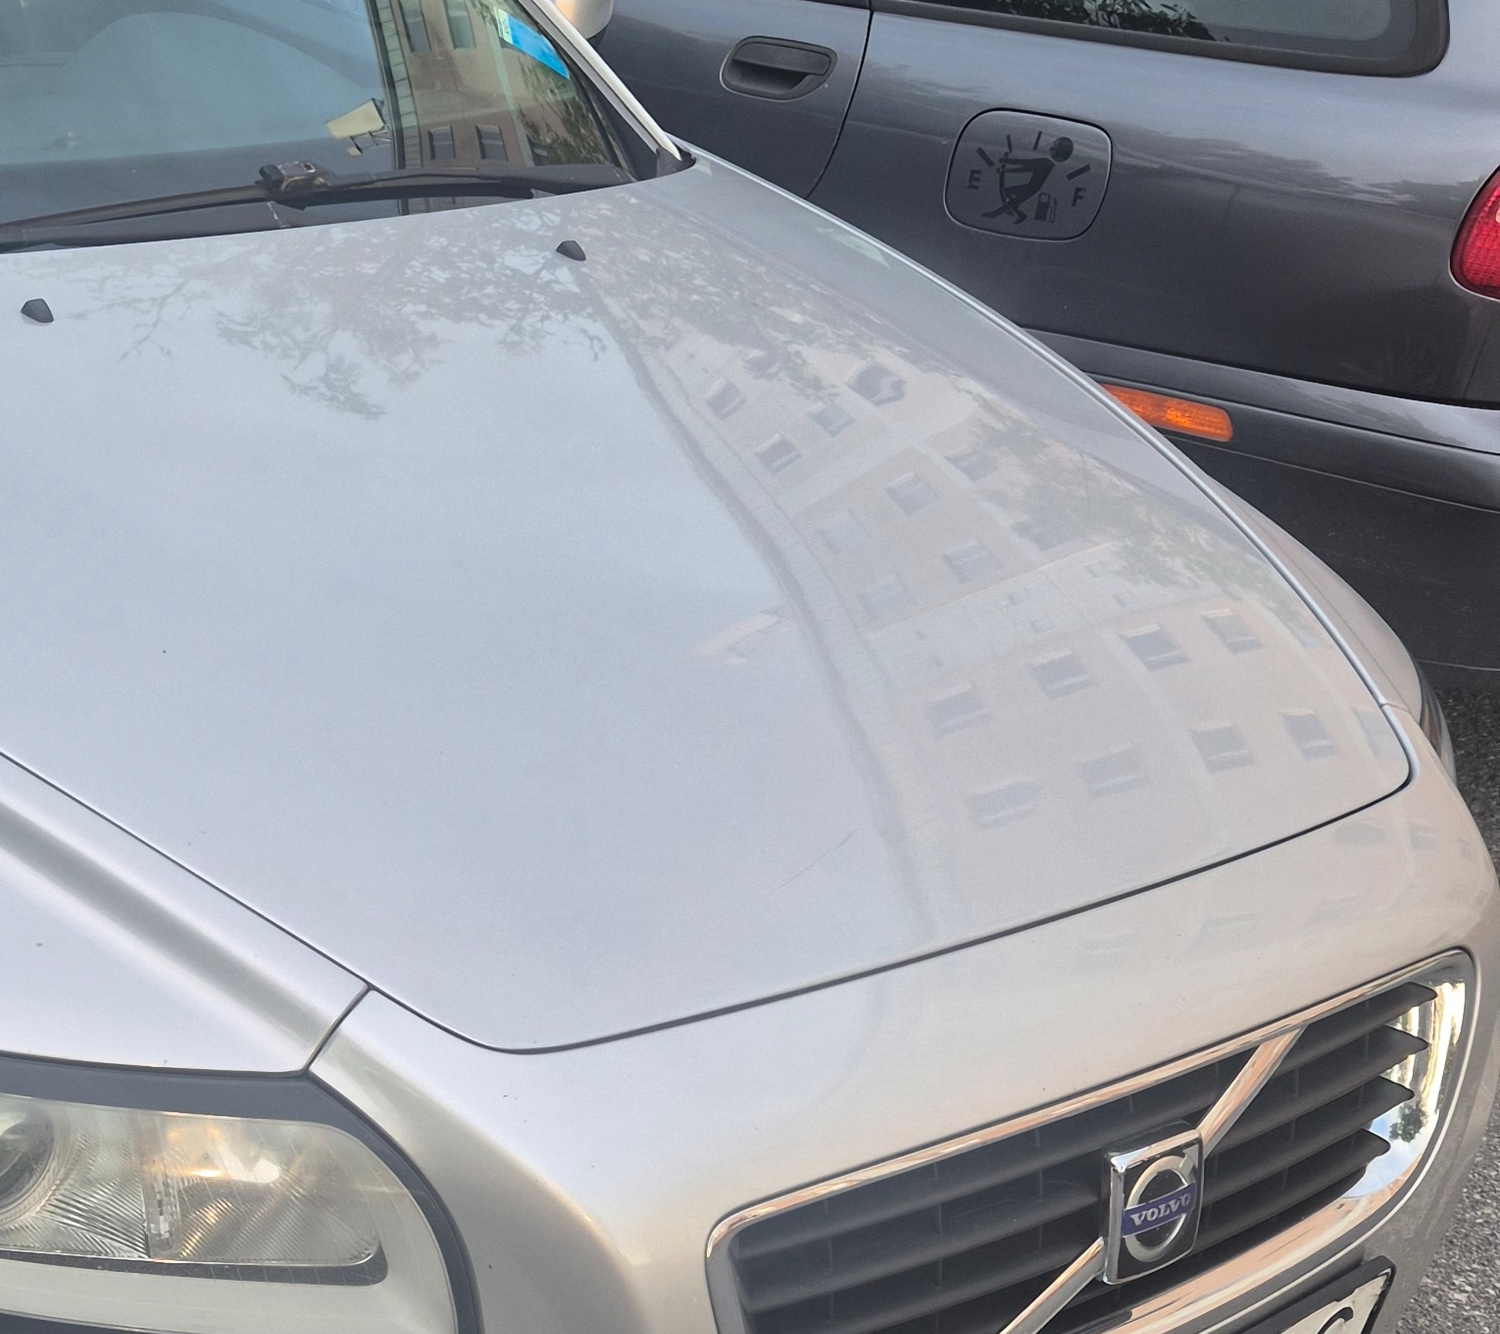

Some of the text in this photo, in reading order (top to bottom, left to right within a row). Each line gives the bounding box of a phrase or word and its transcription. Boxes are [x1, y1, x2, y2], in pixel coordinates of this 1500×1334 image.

[967, 169, 982, 190] E
[1072, 187, 1087, 207] F
[1130, 1193, 1190, 1227] VOLVO
